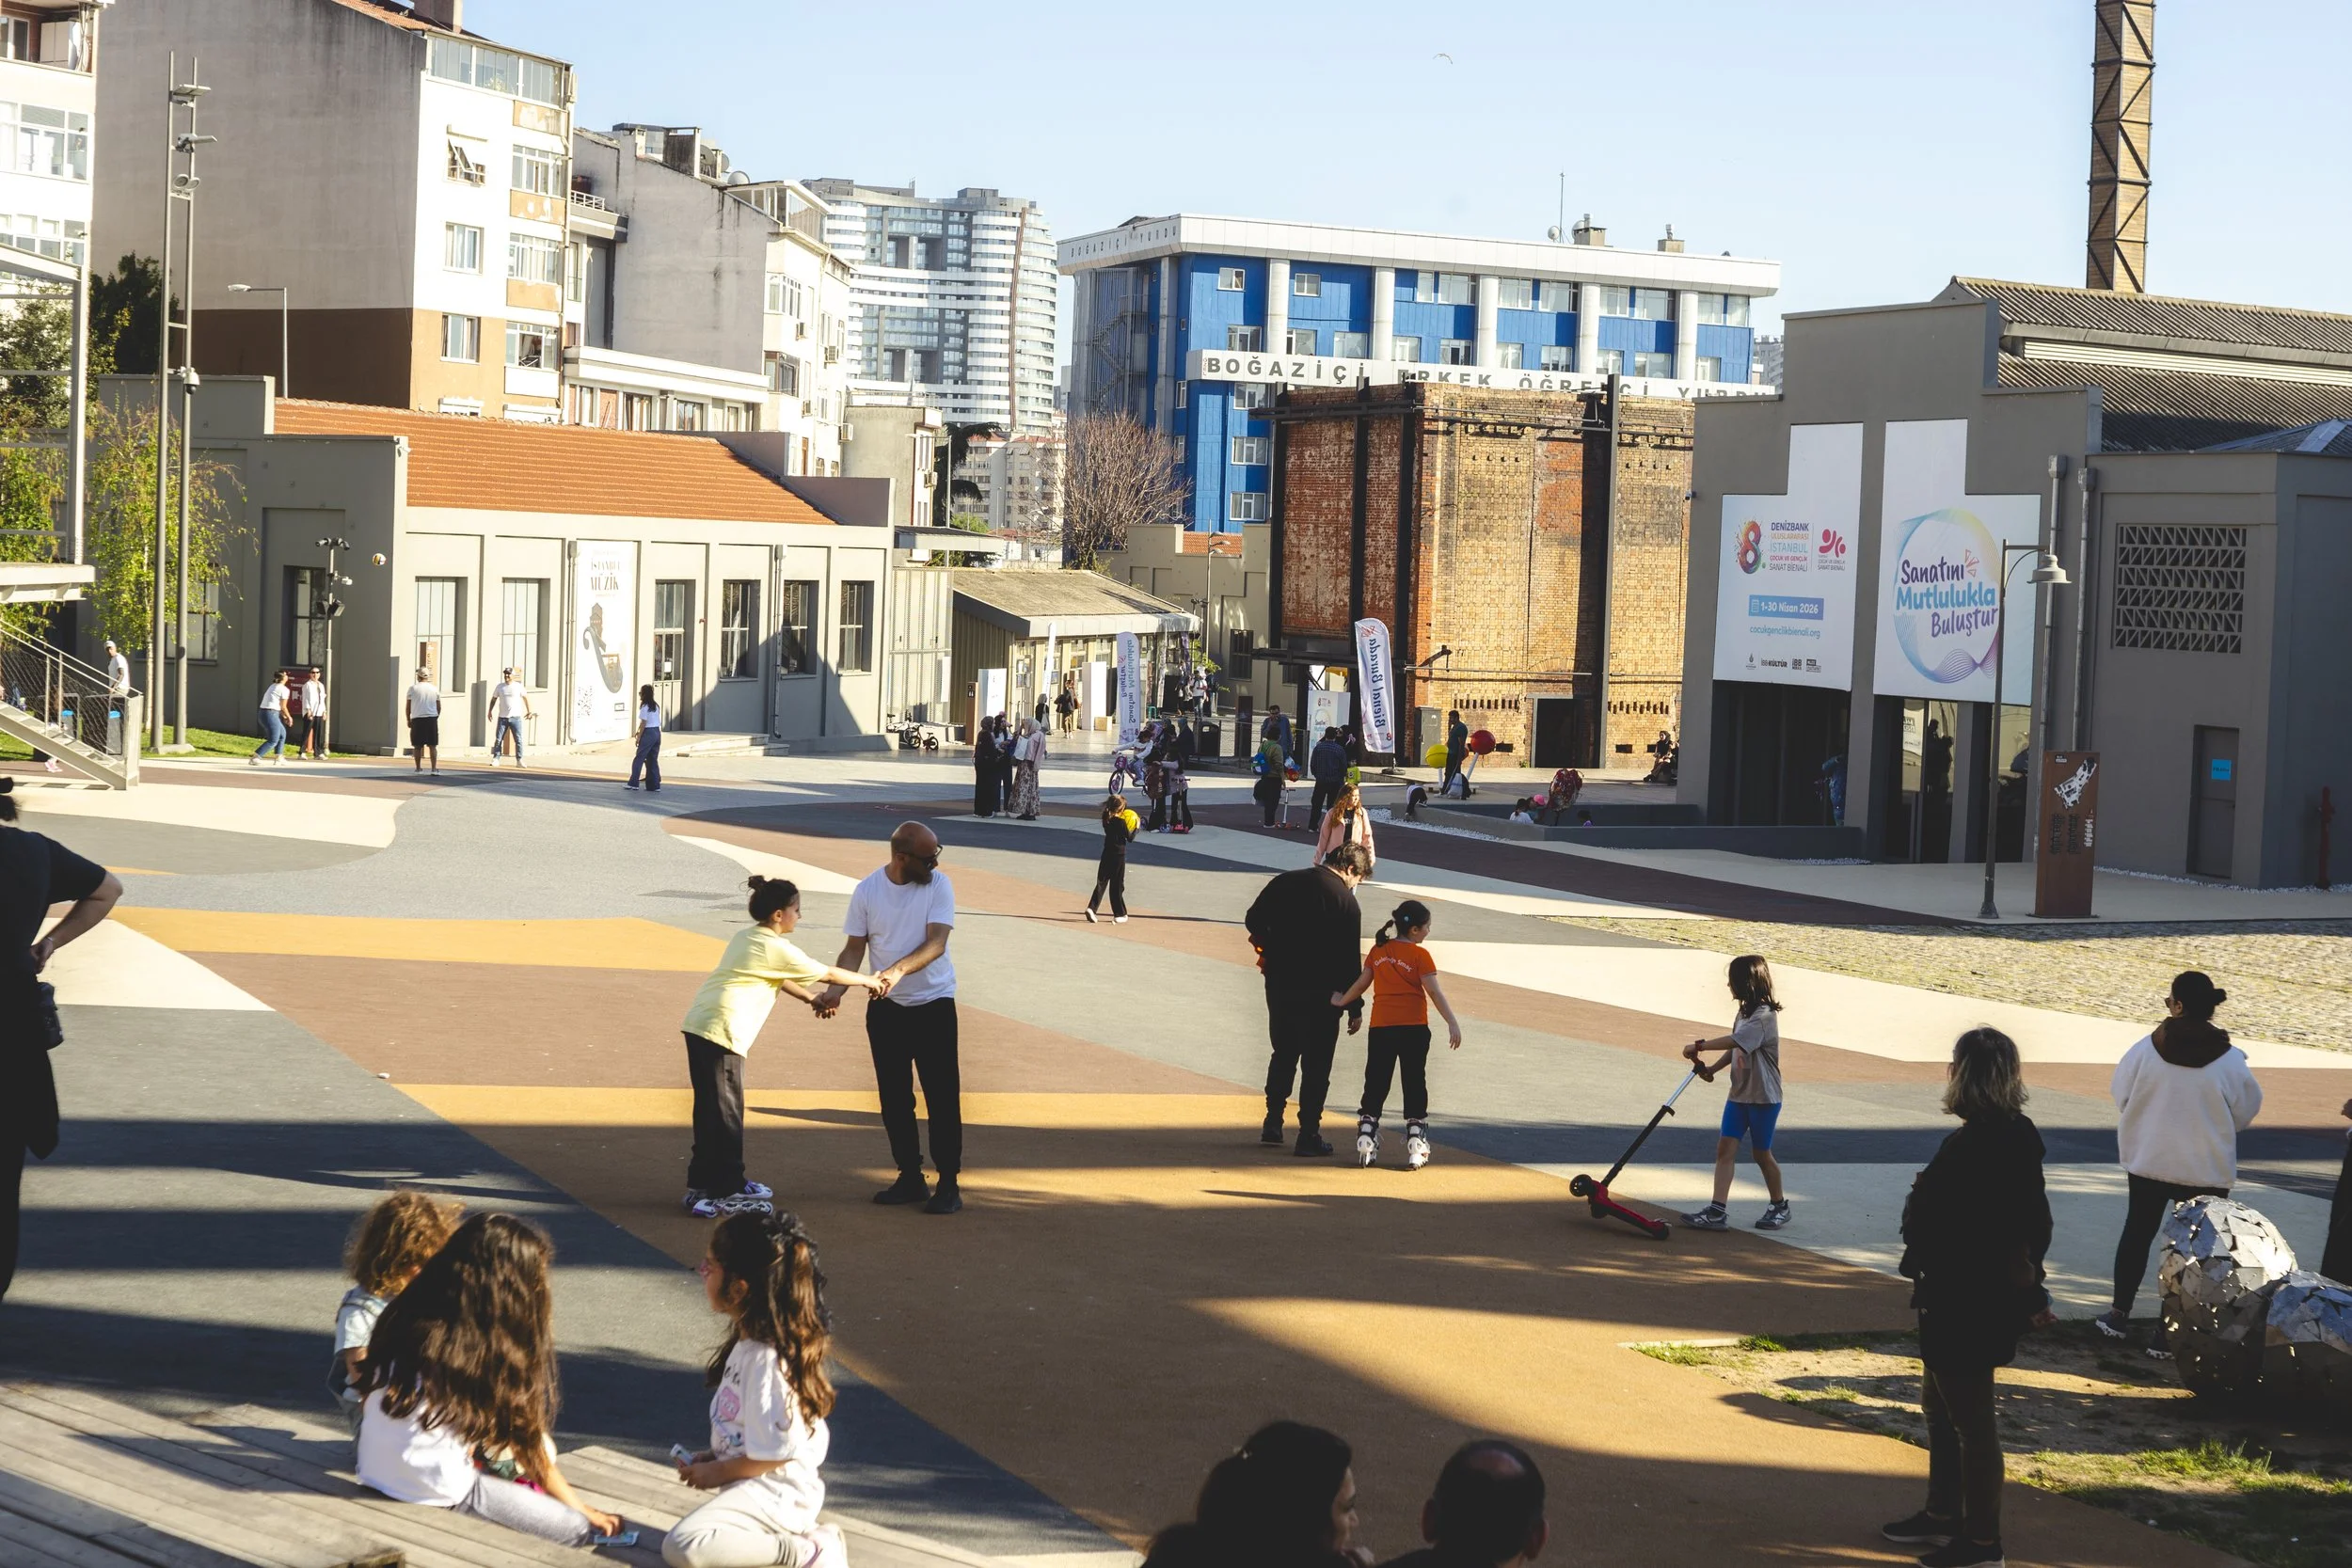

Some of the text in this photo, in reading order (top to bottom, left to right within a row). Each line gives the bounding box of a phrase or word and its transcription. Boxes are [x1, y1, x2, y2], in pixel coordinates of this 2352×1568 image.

[1207, 356, 1364, 385] BOĞAZİÇİ
[1771, 520, 1809, 531] DENİZBANK
[1771, 532, 1809, 541] ULUSLARARASI
[1769, 562, 1787, 571] SANAT
[1901, 556, 1964, 585] Sanatını
[1896, 581, 1996, 611] Mutlulukla
[1760, 601, 1819, 614] 1-30 Nisan 2026
[1931, 607, 1999, 638] Buluştur
